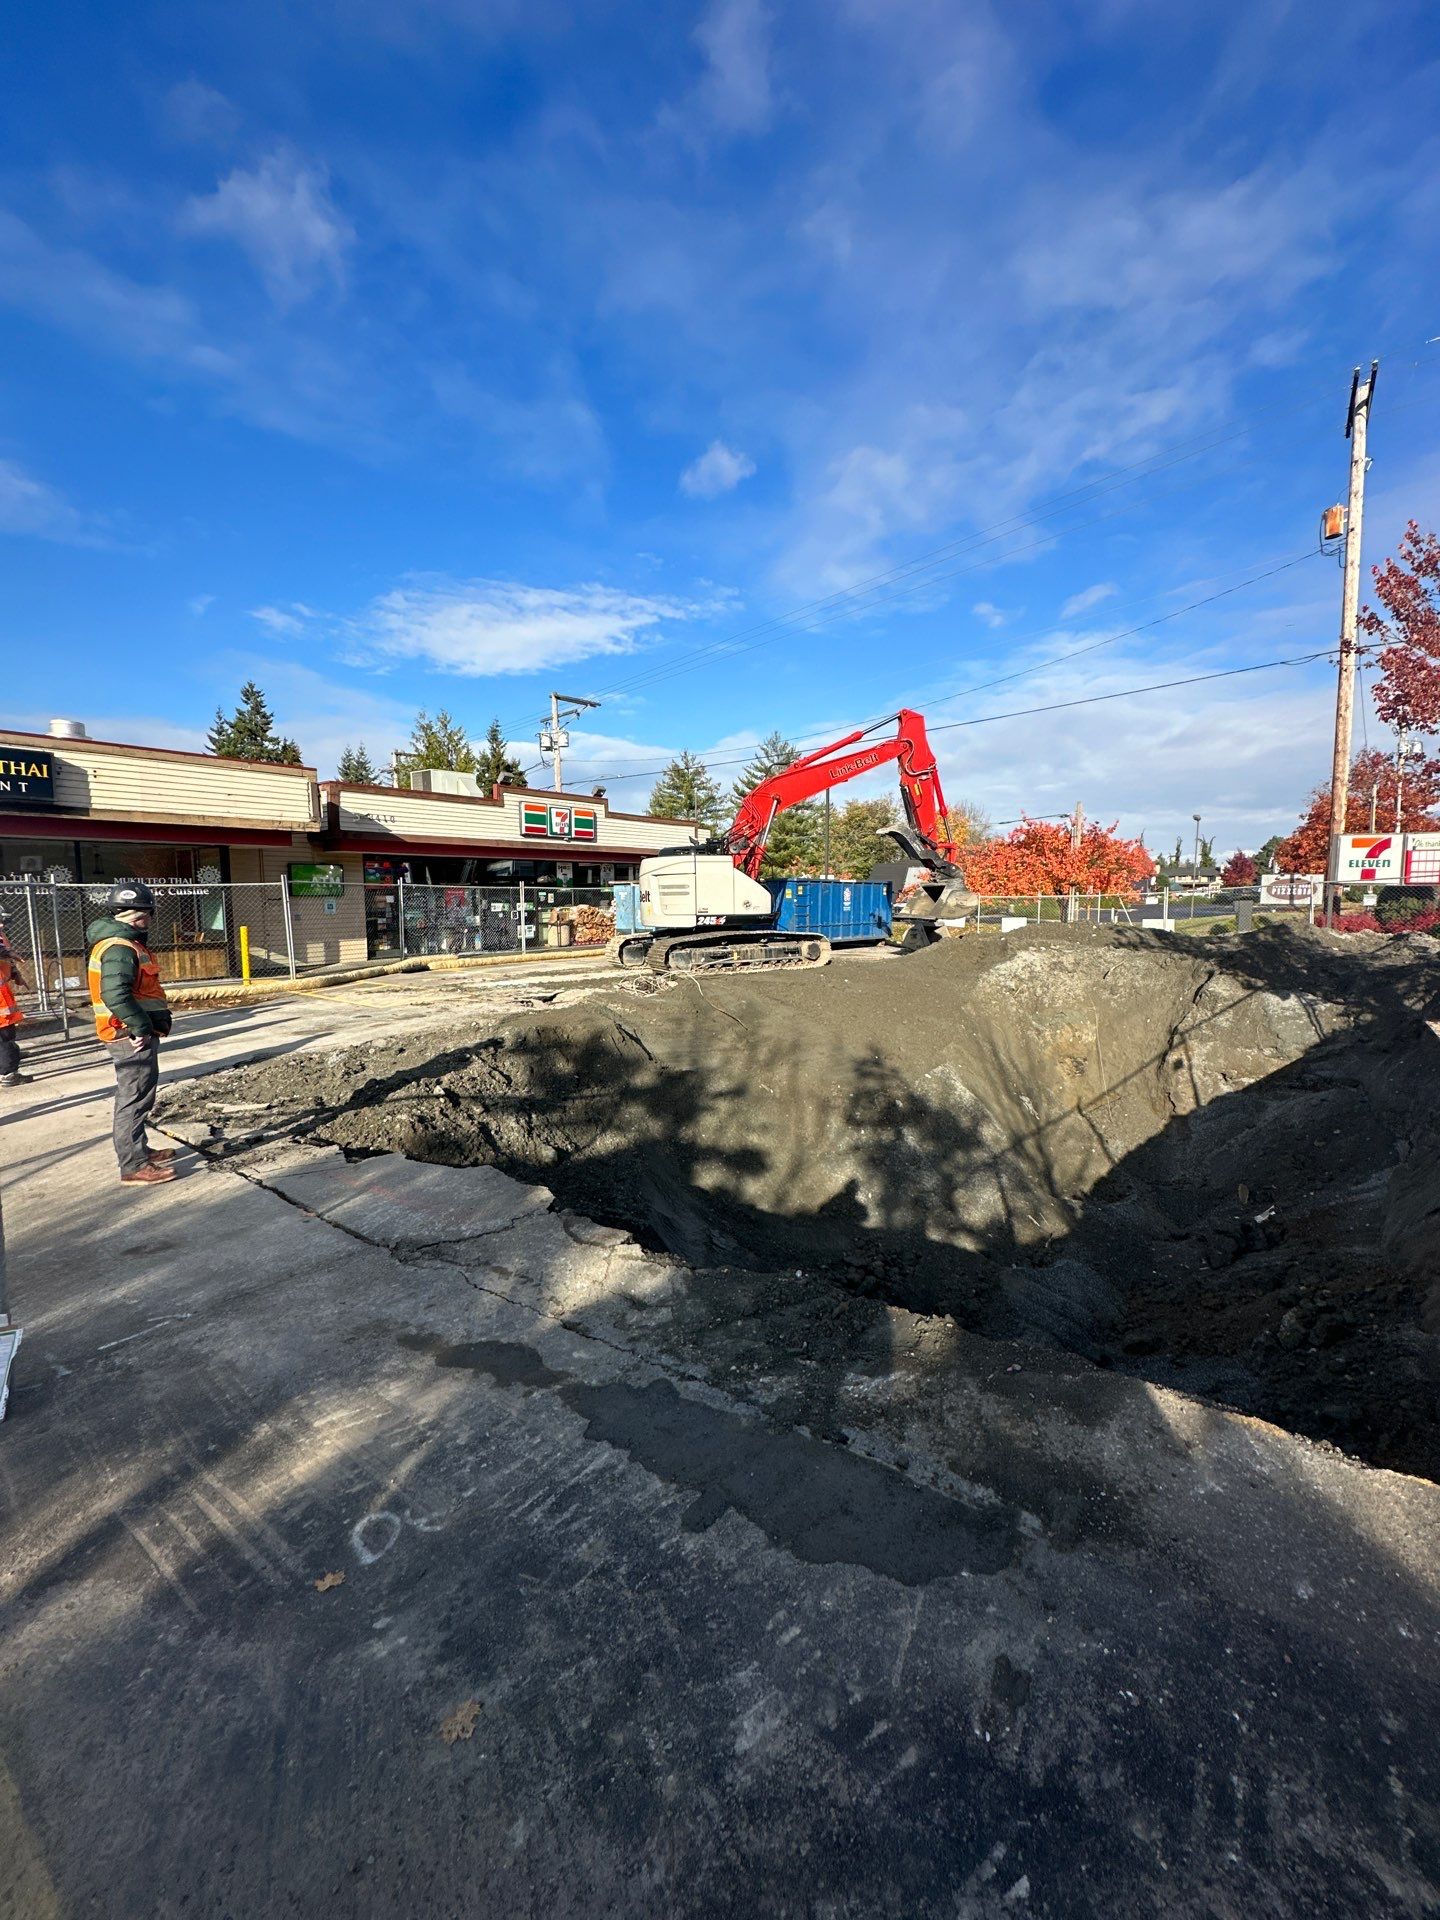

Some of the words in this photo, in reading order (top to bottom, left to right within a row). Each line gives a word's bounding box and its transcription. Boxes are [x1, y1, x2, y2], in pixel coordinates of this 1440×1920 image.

[0, 760, 49, 778] THAI
[829, 753, 879, 778] Link-Belt
[1351, 837, 1392, 880] 7
[168, 877, 193, 885] THAI
[310, 876, 341, 887] ATM
[168, 886, 210, 896] Cuisine
